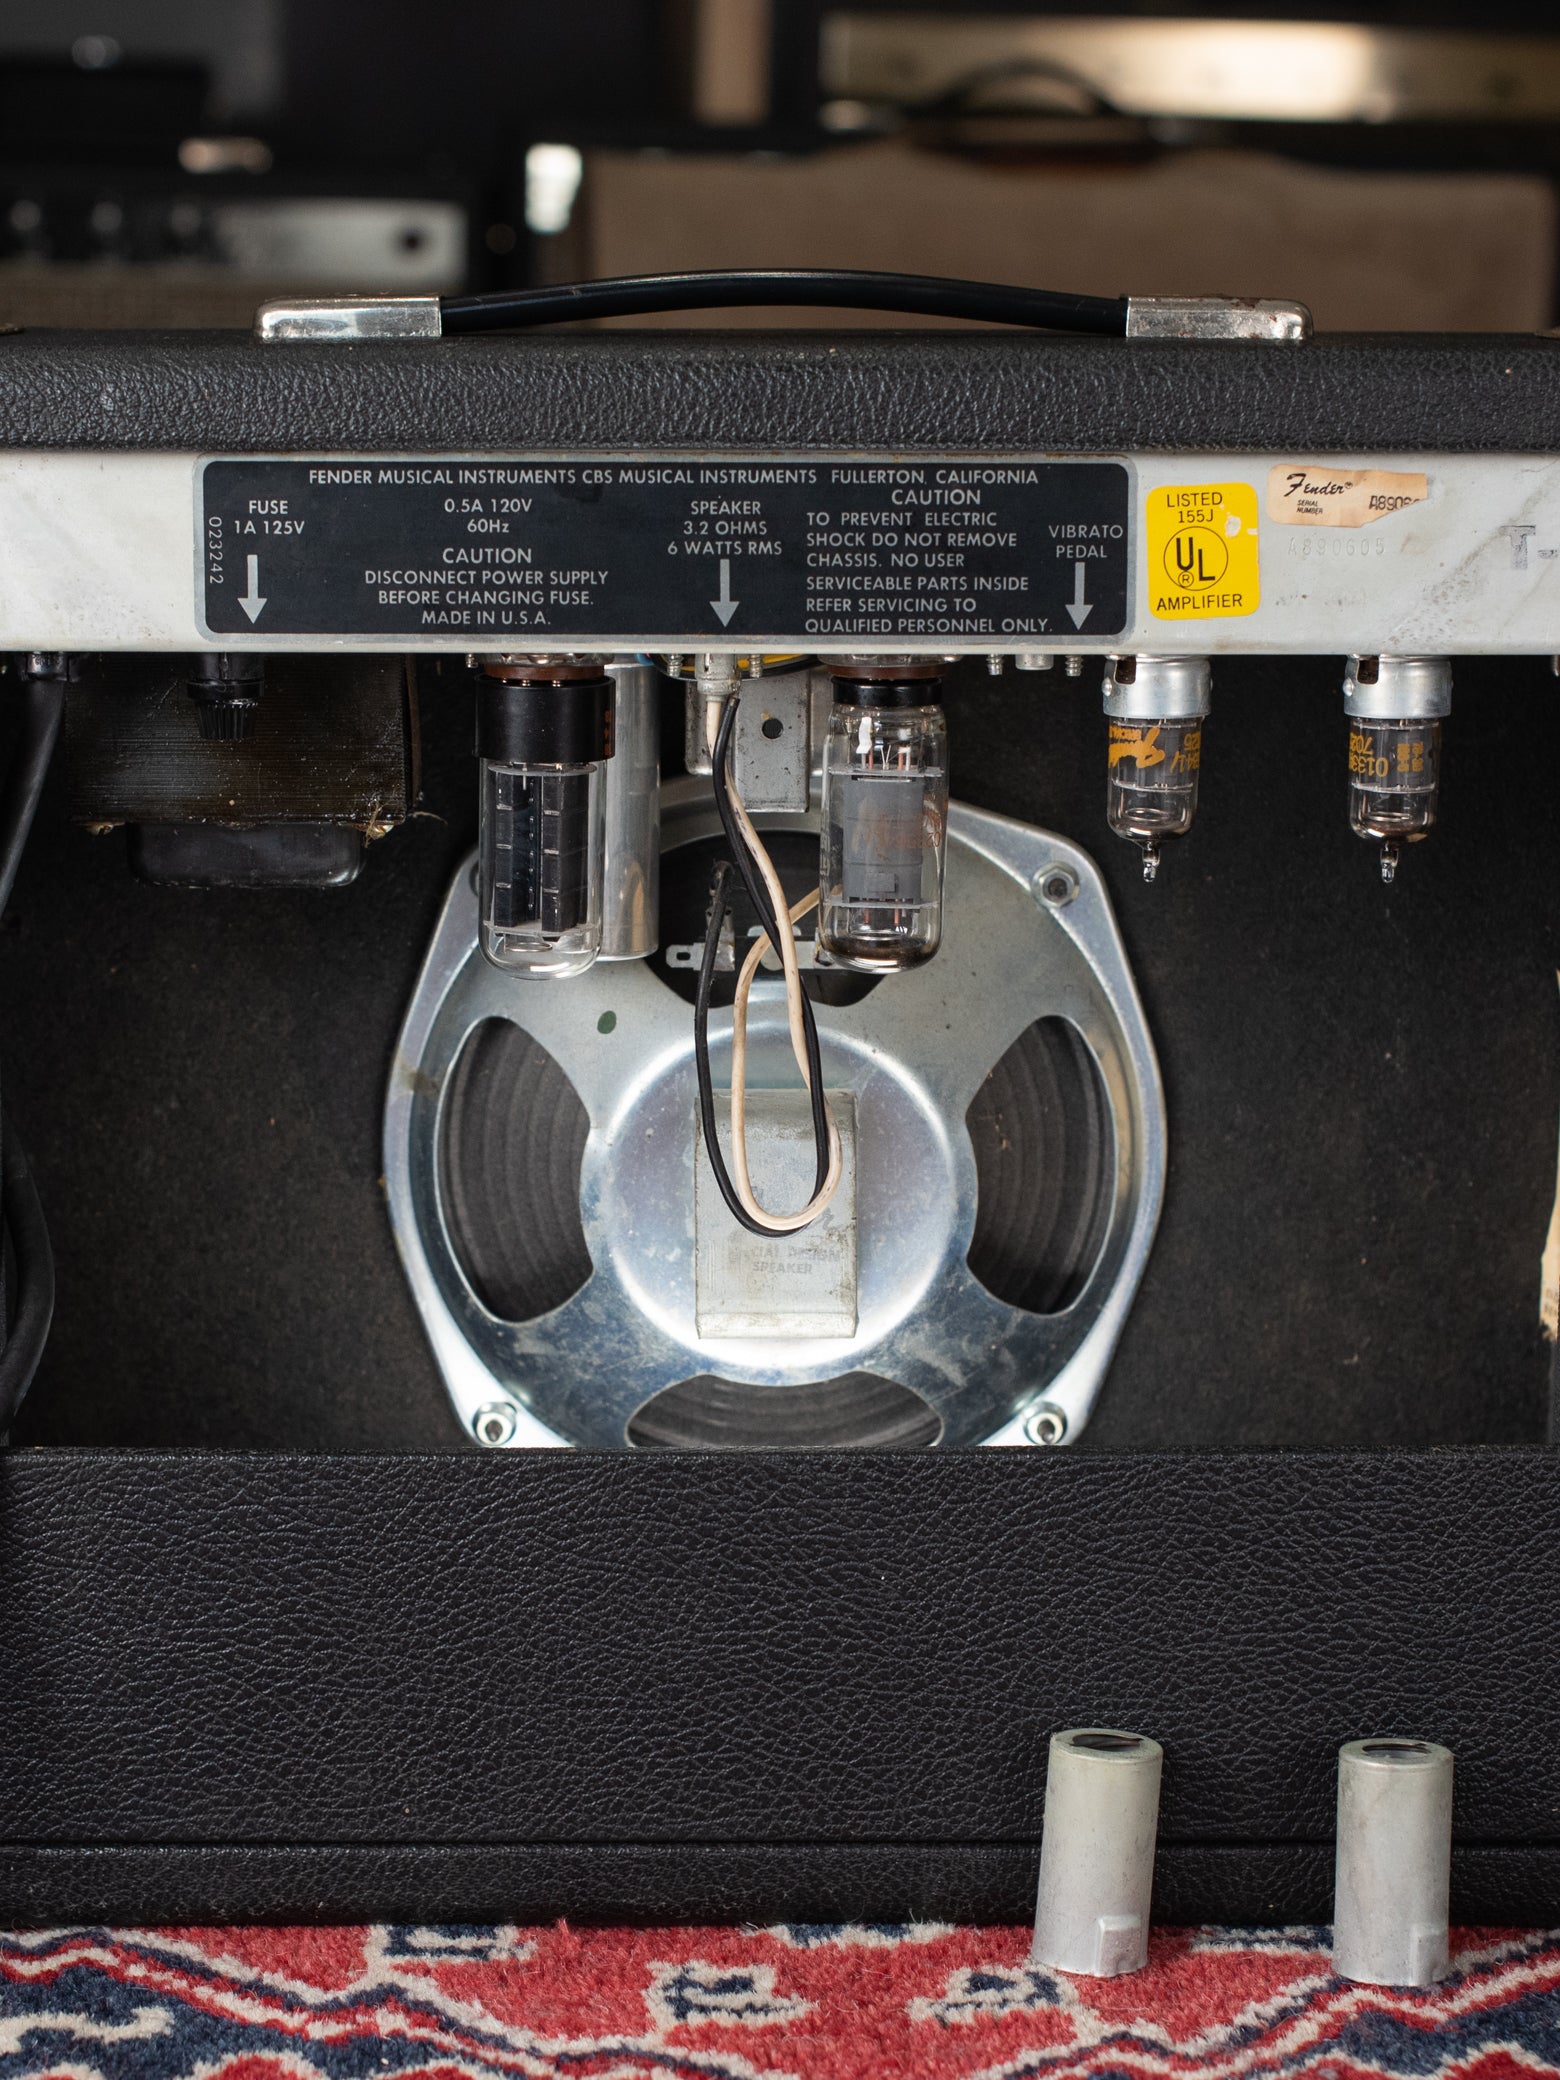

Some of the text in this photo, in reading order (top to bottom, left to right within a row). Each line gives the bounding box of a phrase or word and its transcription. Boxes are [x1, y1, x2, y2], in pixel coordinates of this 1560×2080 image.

[310, 470, 371, 484] FENDER
[378, 470, 453, 484] MUSICAL
[459, 470, 575, 484] INSTRUMENTS
[583, 470, 612, 483] CBS
[619, 470, 694, 483] MUSICAL
[701, 470, 816, 483] INSTRUMENTS
[936, 470, 1038, 483] CALIFORNIA
[892, 489, 980, 505] CAUTION
[1166, 492, 1223, 508] LISTED
[1297, 499, 1319, 507] SERIAL
[249, 500, 287, 514] FUSE
[445, 499, 532, 512] 0.5A 120V
[691, 501, 760, 514] SPEAKER
[1296, 507, 1324, 515] NUMBER
[807, 512, 996, 526] TO PREVENT ELECTRIC
[1178, 509, 1215, 523] 155J
[235, 521, 304, 534] 1A 125V
[467, 519, 509, 532] 60Hz
[684, 521, 767, 535] 3.2 OHMS
[1049, 525, 1123, 538] VIBRATO
[807, 533, 1016, 546] SHOCK DO NOT REMOVE
[1287, 537, 1386, 556] A890605
[209, 517, 223, 583] 023242
[668, 541, 781, 555] 6 WATTS RMS
[1057, 545, 1107, 558] PEDAL
[443, 548, 531, 563] CAUTION
[807, 553, 964, 567] CHASSIS. NO USER
[365, 570, 608, 584] DISCONNECT POWER SUPPLY
[807, 577, 1028, 590] SERVICEABLE PARTS INSIDE
[379, 591, 593, 604] BEFORE CHANGING FUSE.
[1156, 593, 1243, 611] AMPLIFIER
[807, 598, 976, 612] REFER SERVICING TO
[422, 611, 550, 624] MADE IN U.S.A.
[805, 619, 1052, 632] QUALIFIED PERSONNEL ONLY.
[752, 1261, 813, 1274] SPEAKER
